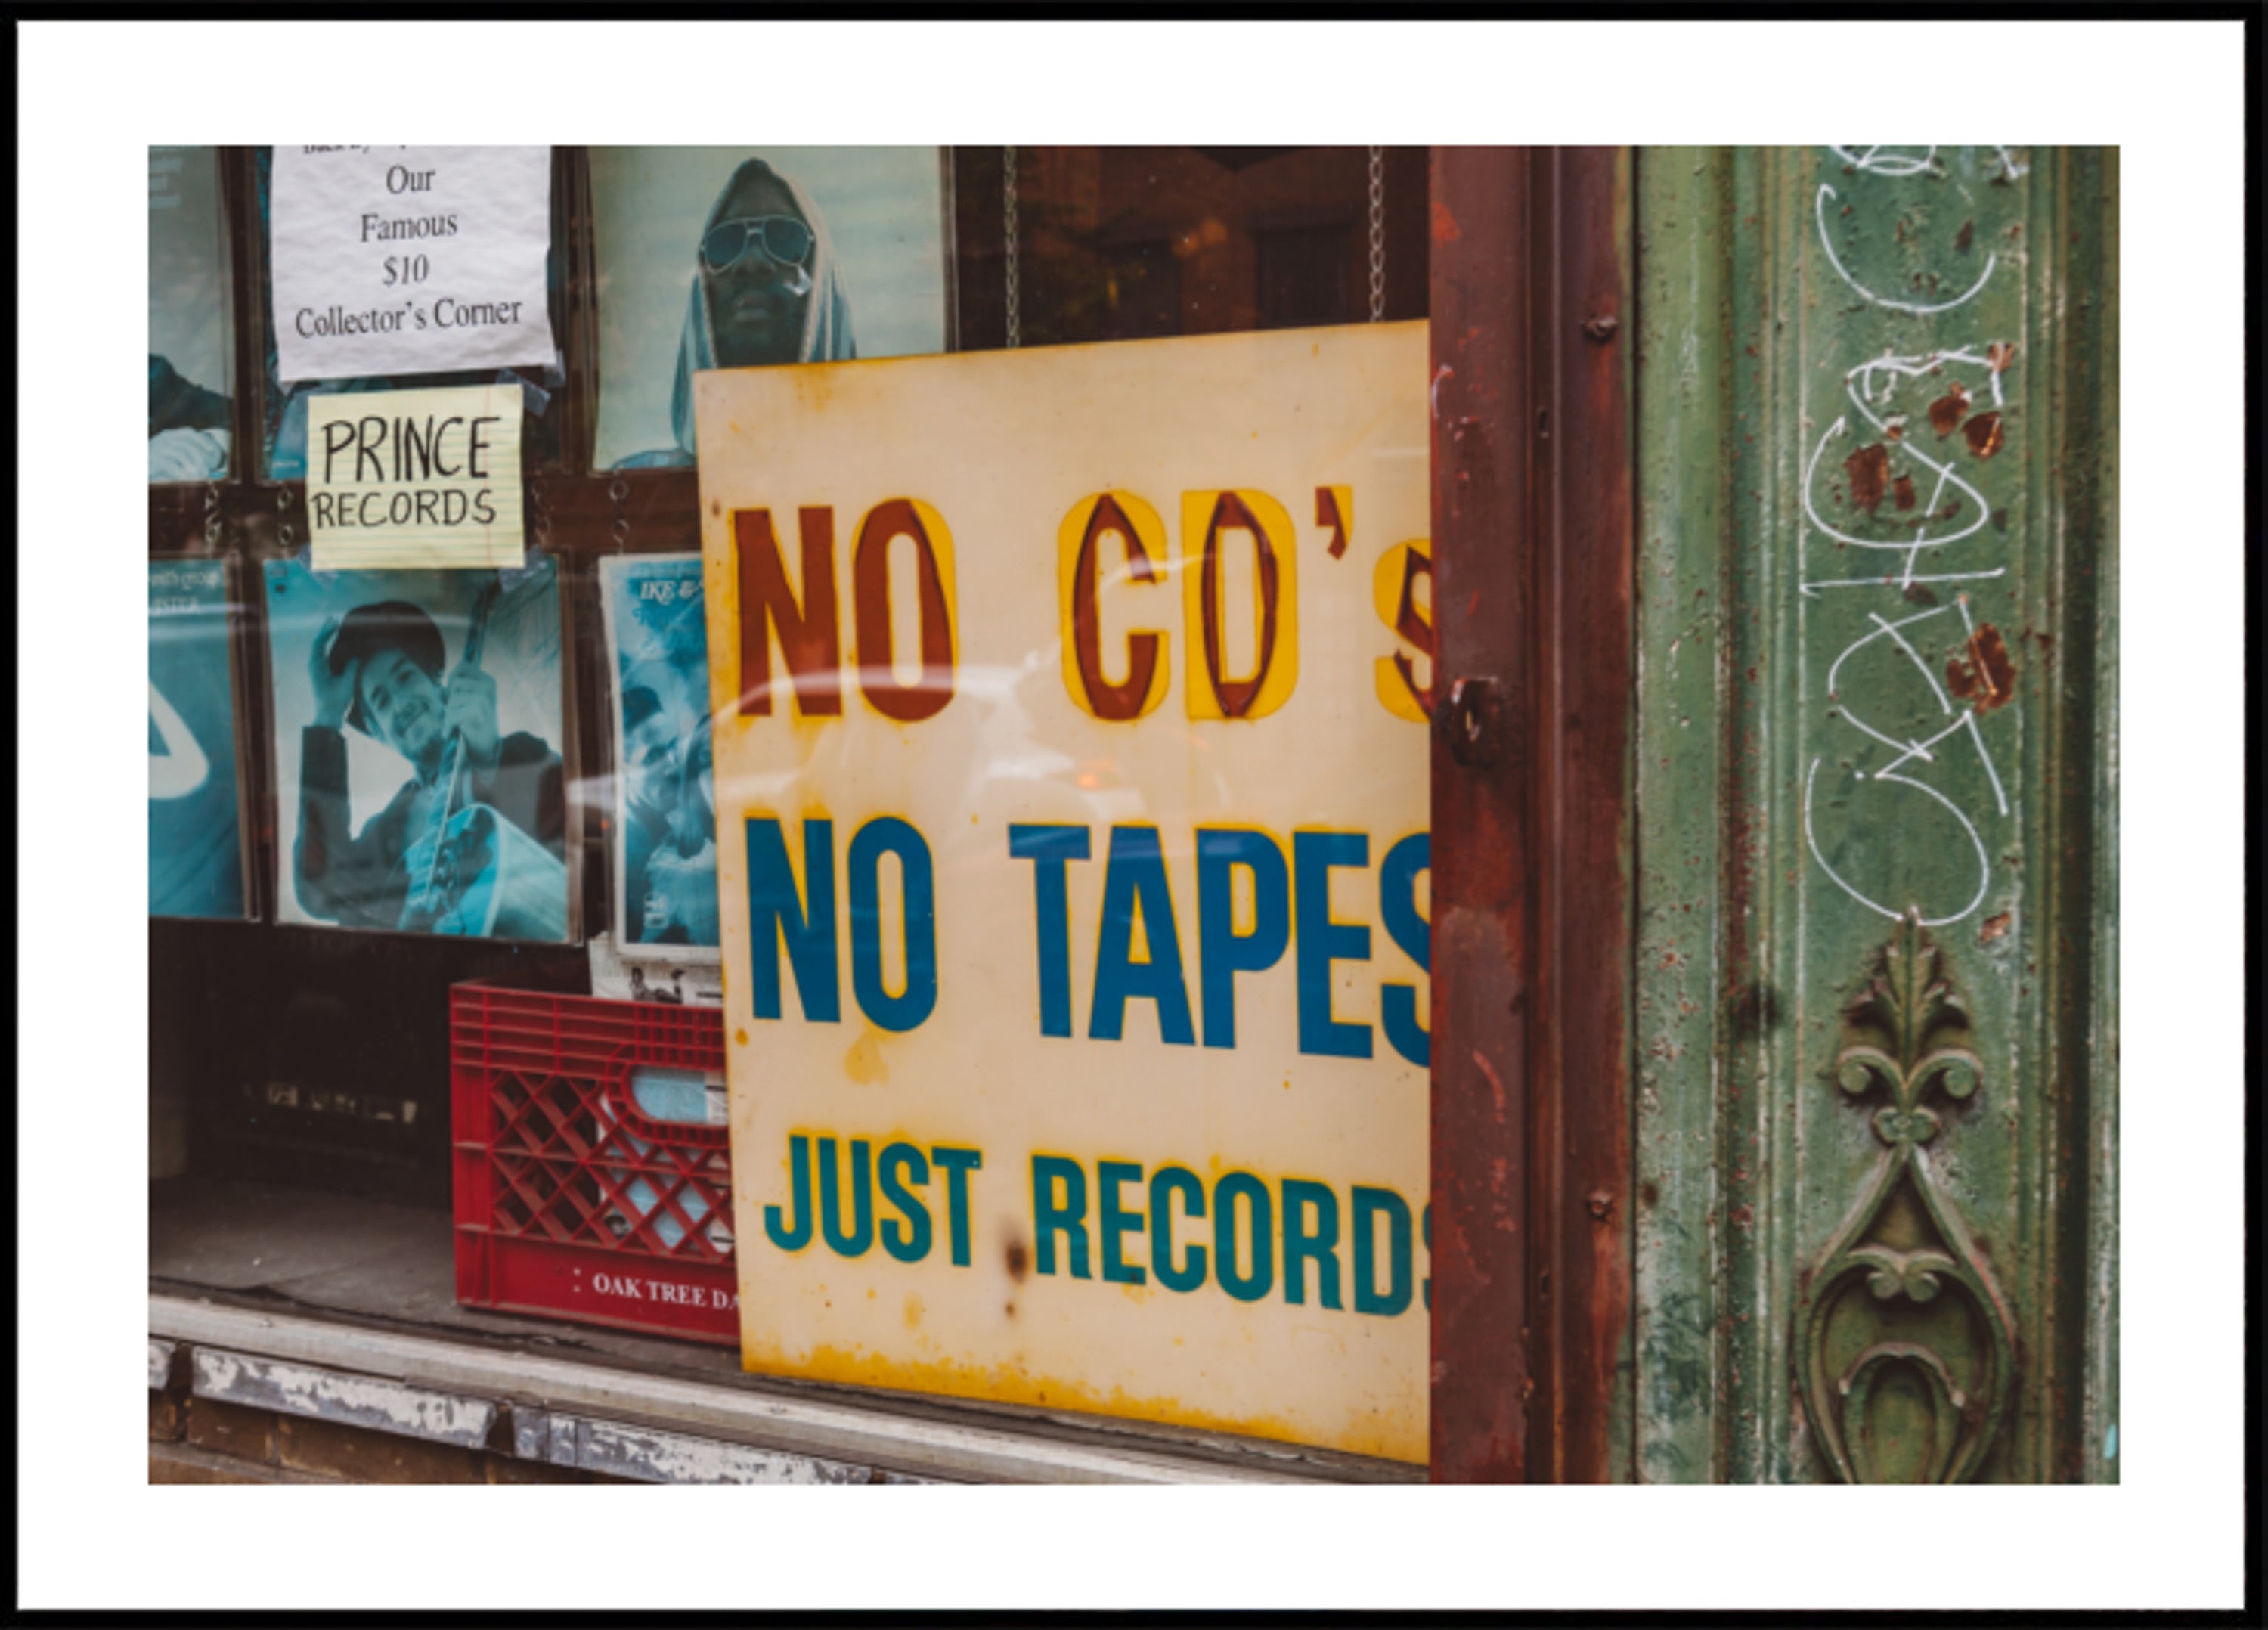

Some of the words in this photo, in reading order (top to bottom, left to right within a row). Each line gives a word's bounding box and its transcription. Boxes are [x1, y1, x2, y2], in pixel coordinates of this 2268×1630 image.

[386, 166, 436, 194] Our
[360, 212, 458, 243] Famous
[382, 255, 429, 286] $10
[295, 302, 427, 339] Collector's
[434, 297, 523, 327] Corner
[321, 416, 501, 485] PRINCE
[311, 488, 497, 528] RECORDS
[640, 580, 677, 605] IKE
[730, 496, 957, 723] NO
[744, 816, 938, 1033] NO
[764, 1134, 983, 1268] JUST
[1030, 1154, 1431, 1318] RECORD
[592, 1272, 642, 1299] OAK
[646, 1281, 706, 1307] TREE
